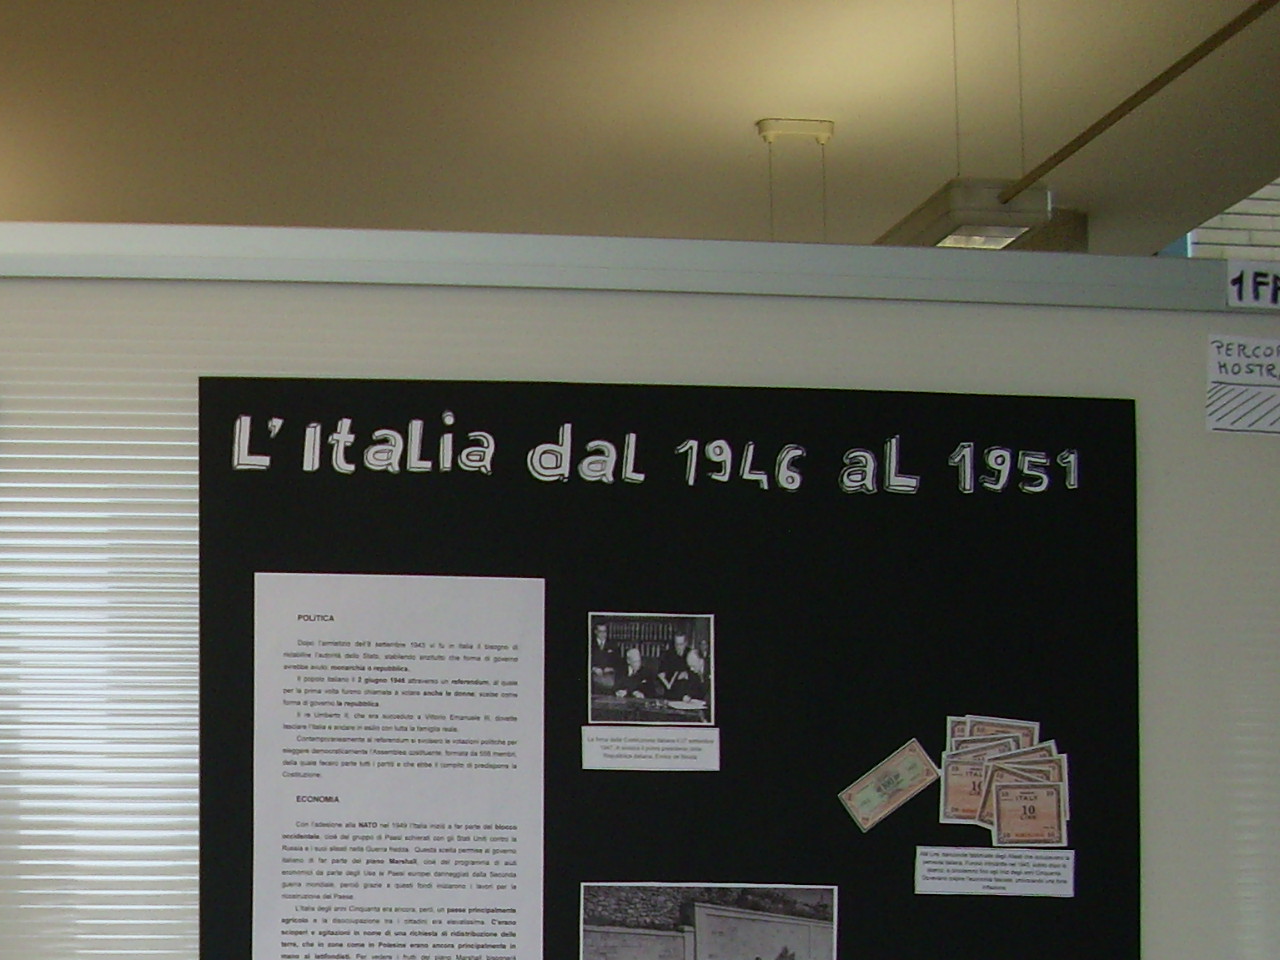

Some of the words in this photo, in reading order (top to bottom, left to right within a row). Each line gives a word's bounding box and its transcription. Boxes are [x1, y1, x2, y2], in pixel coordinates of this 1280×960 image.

[1230, 269, 1280, 304] 1F
[1217, 361, 1280, 377] MOSTR
[526, 422, 646, 484] dal
[675, 438, 807, 493] 1946
[948, 441, 1080, 494] 1951
[1022, 805, 1035, 815] 10
